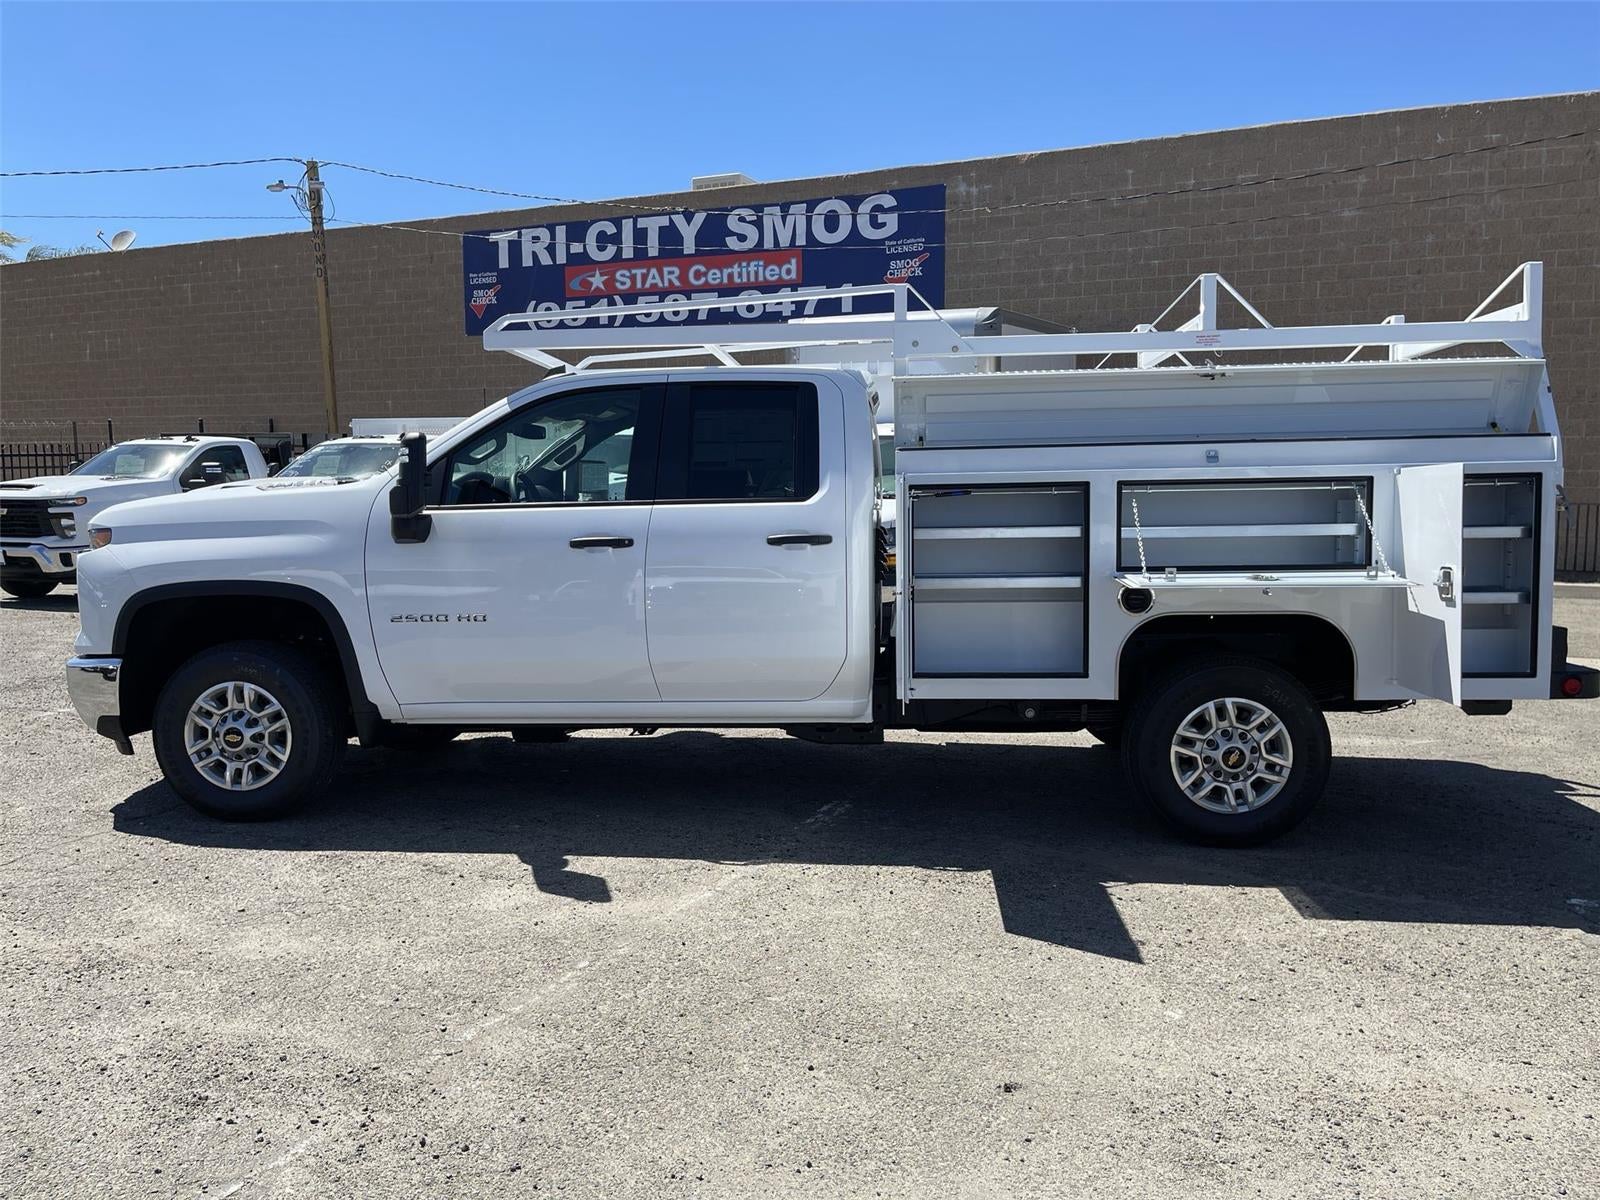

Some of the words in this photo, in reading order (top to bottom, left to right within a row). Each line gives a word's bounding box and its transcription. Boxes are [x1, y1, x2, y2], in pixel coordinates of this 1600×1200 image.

[489, 212, 708, 269] TRI-CITY
[725, 193, 899, 252] SMOG
[885, 243, 924, 254] LICENSED
[889, 259, 920, 270] SMOG
[615, 266, 680, 290] STAR
[689, 256, 797, 286] Certified
[887, 267, 923, 279] CHECK
[469, 276, 497, 285] LICENSED
[473, 289, 495, 298] SMOG
[471, 296, 498, 305] CHECK
[526, 295, 625, 332] (951)
[390, 614, 448, 623] 2500
[457, 613, 487, 623] HD
